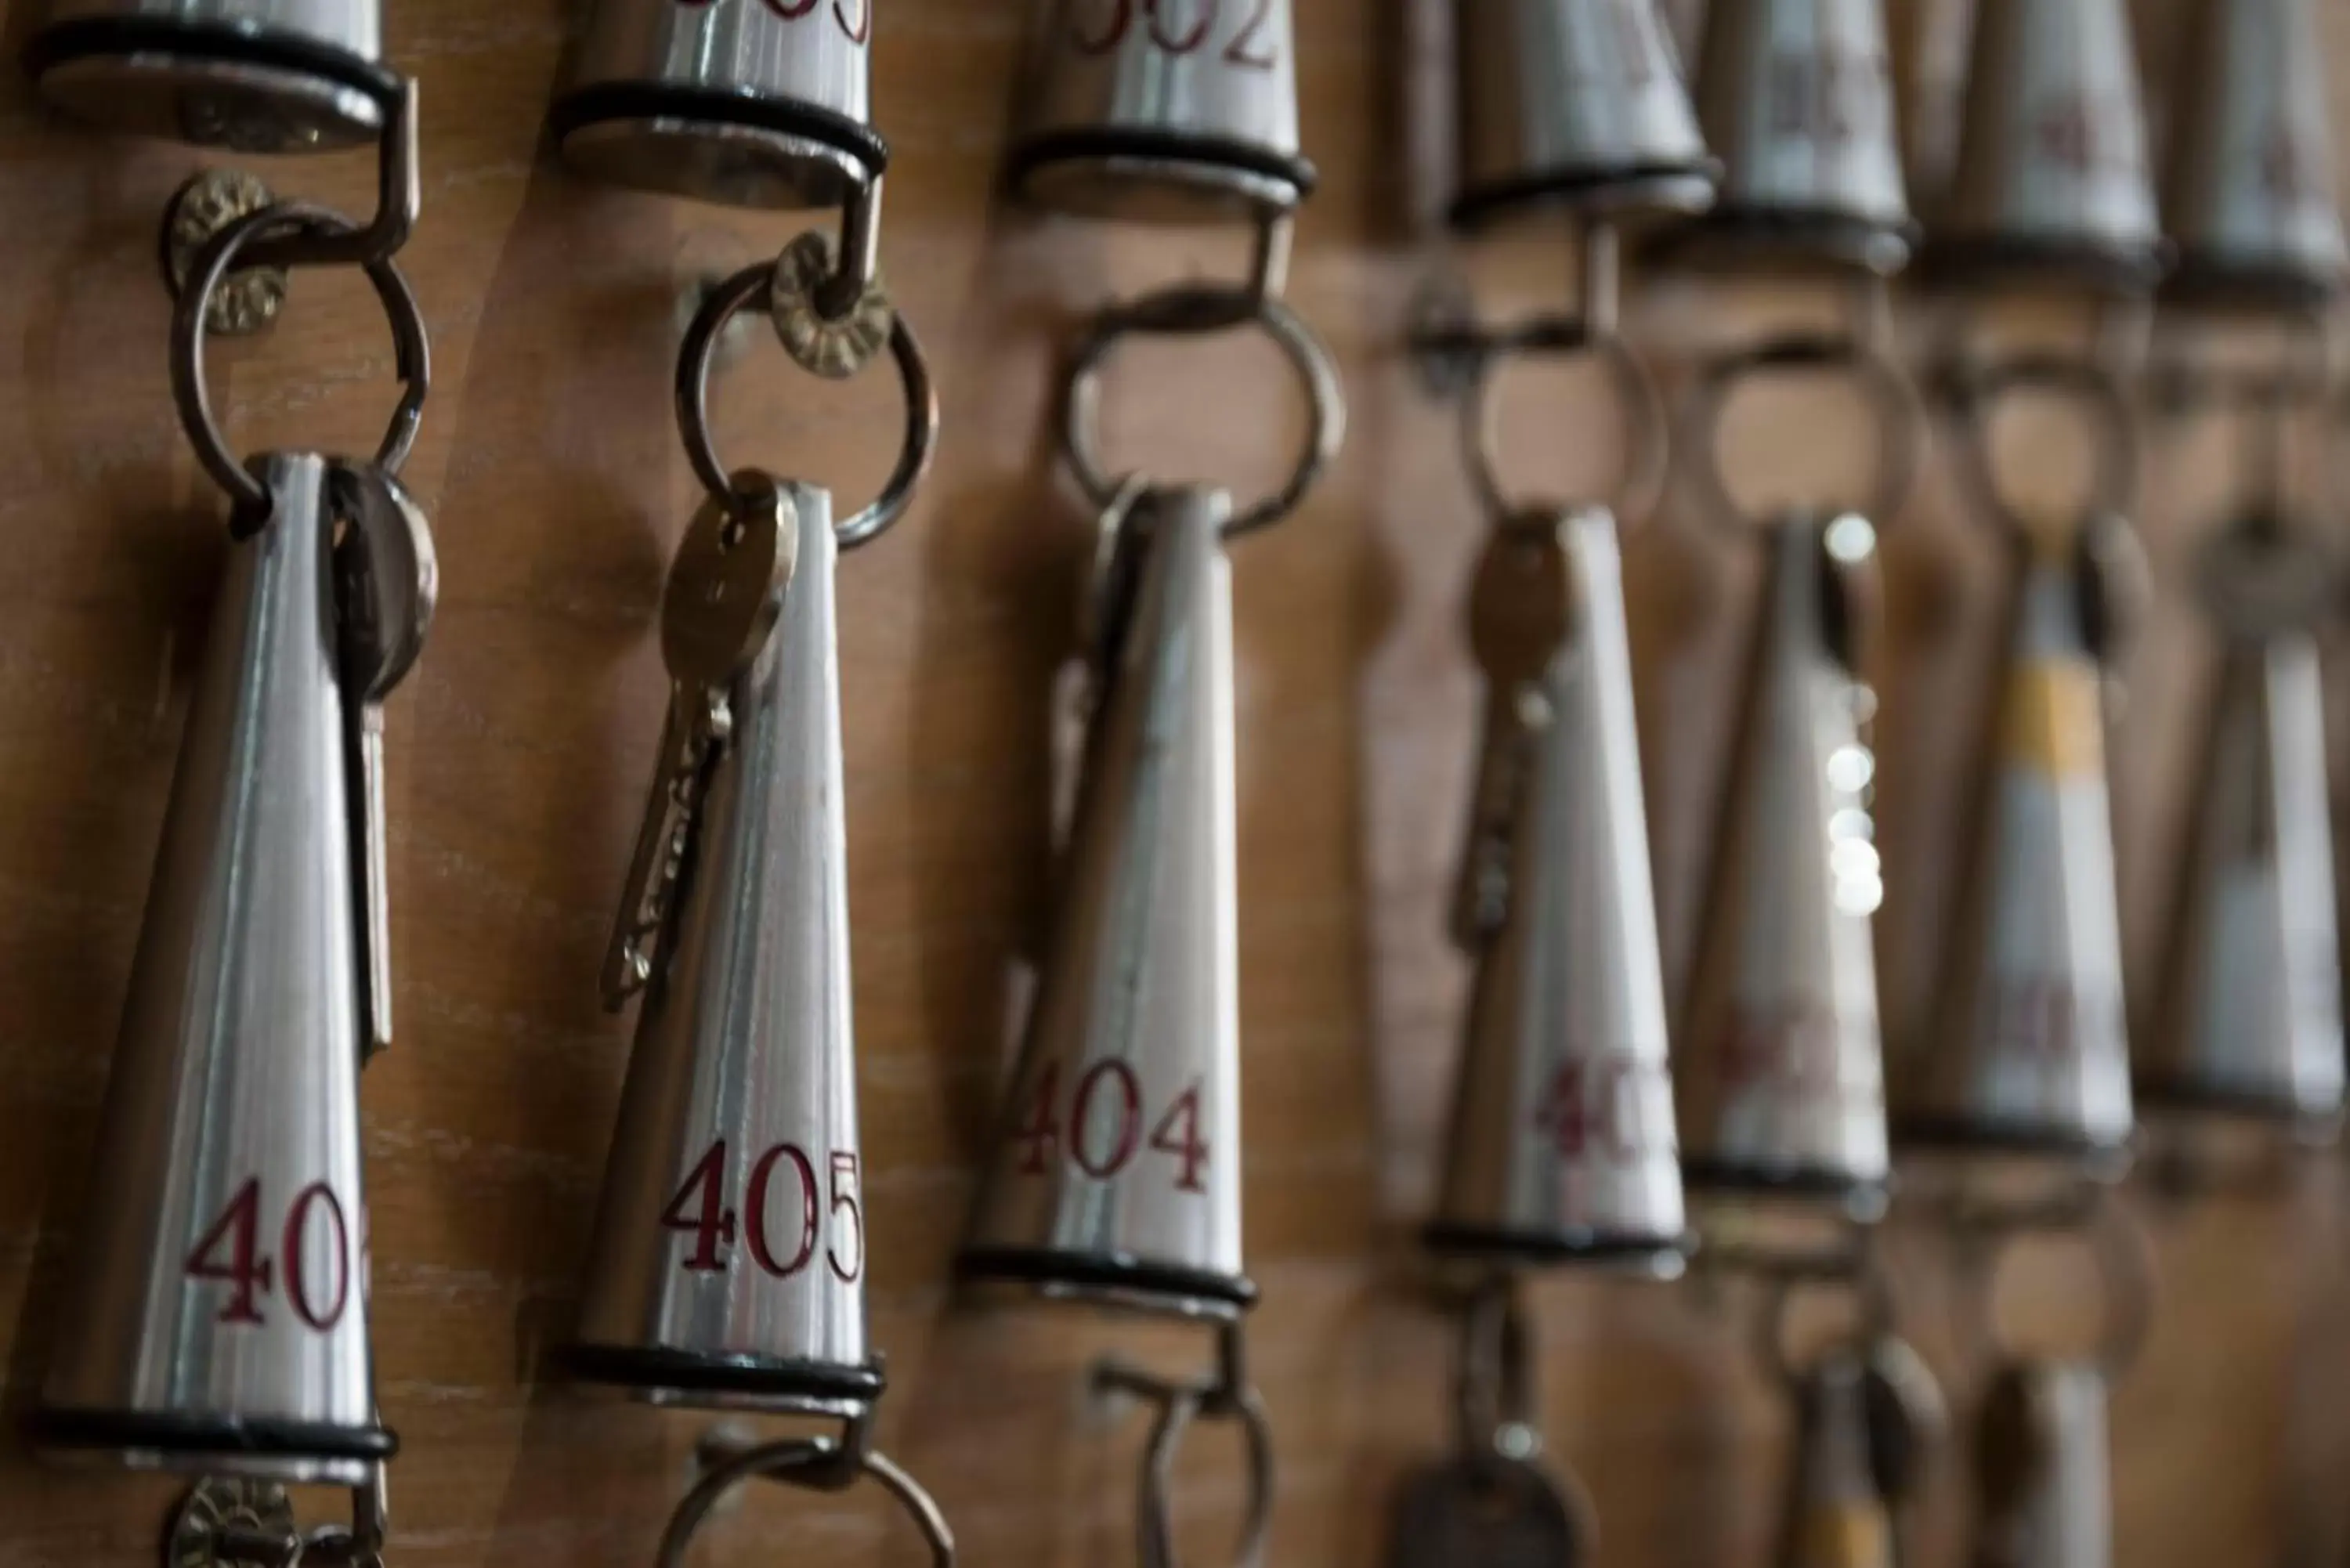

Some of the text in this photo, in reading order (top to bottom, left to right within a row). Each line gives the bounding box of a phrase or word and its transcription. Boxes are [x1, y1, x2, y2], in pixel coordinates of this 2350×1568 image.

[1003, 1057, 1212, 1195] 404
[183, 1173, 372, 1335] 40
[660, 1136, 863, 1283] 405
